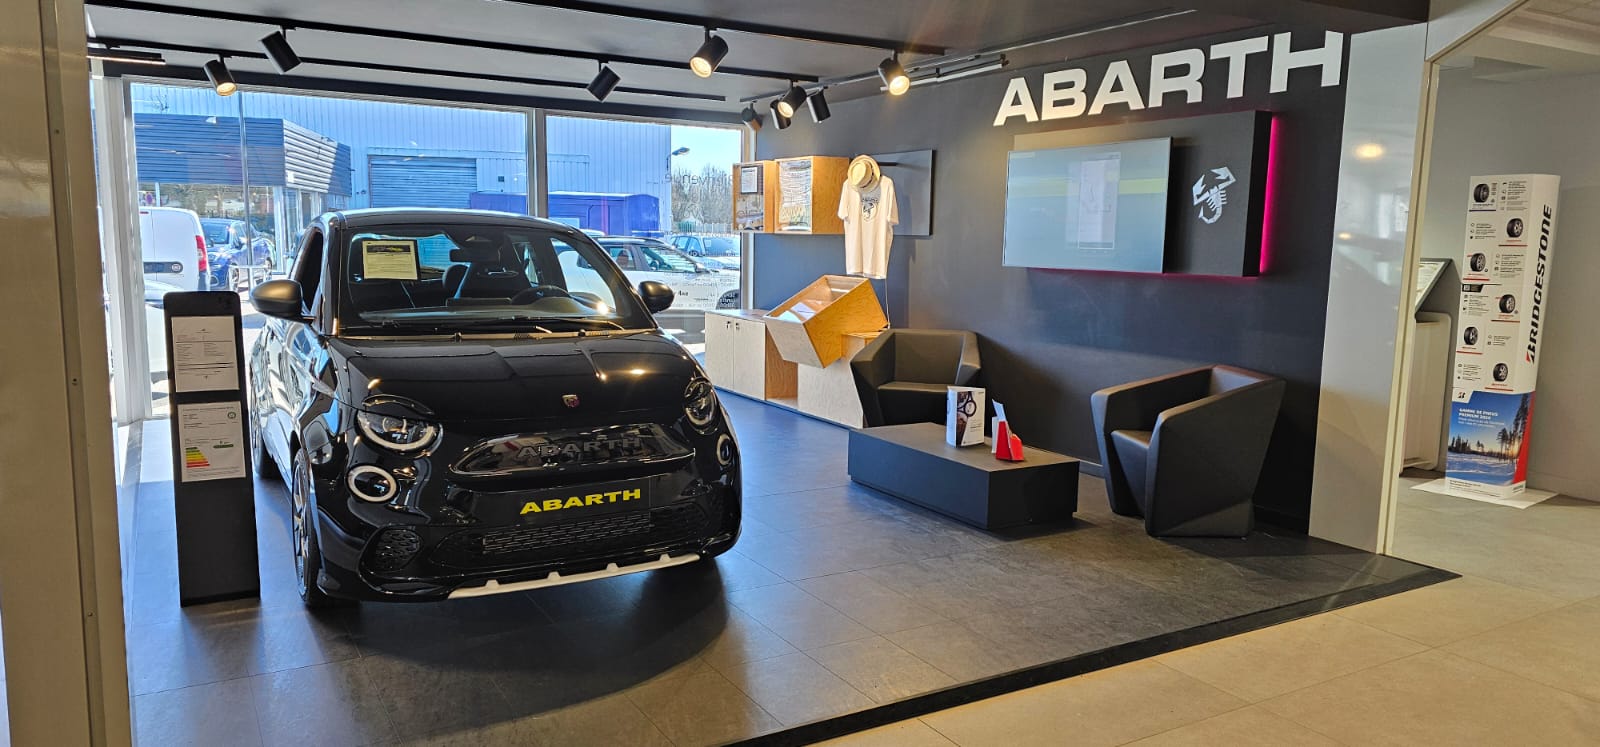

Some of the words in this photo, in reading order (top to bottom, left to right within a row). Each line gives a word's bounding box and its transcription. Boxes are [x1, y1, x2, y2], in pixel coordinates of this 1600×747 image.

[993, 30, 1344, 126] ABARTH
[1525, 204, 1552, 364] BRIDGESTONE
[517, 437, 641, 458] ABARTH
[519, 488, 641, 515] ABARTH
